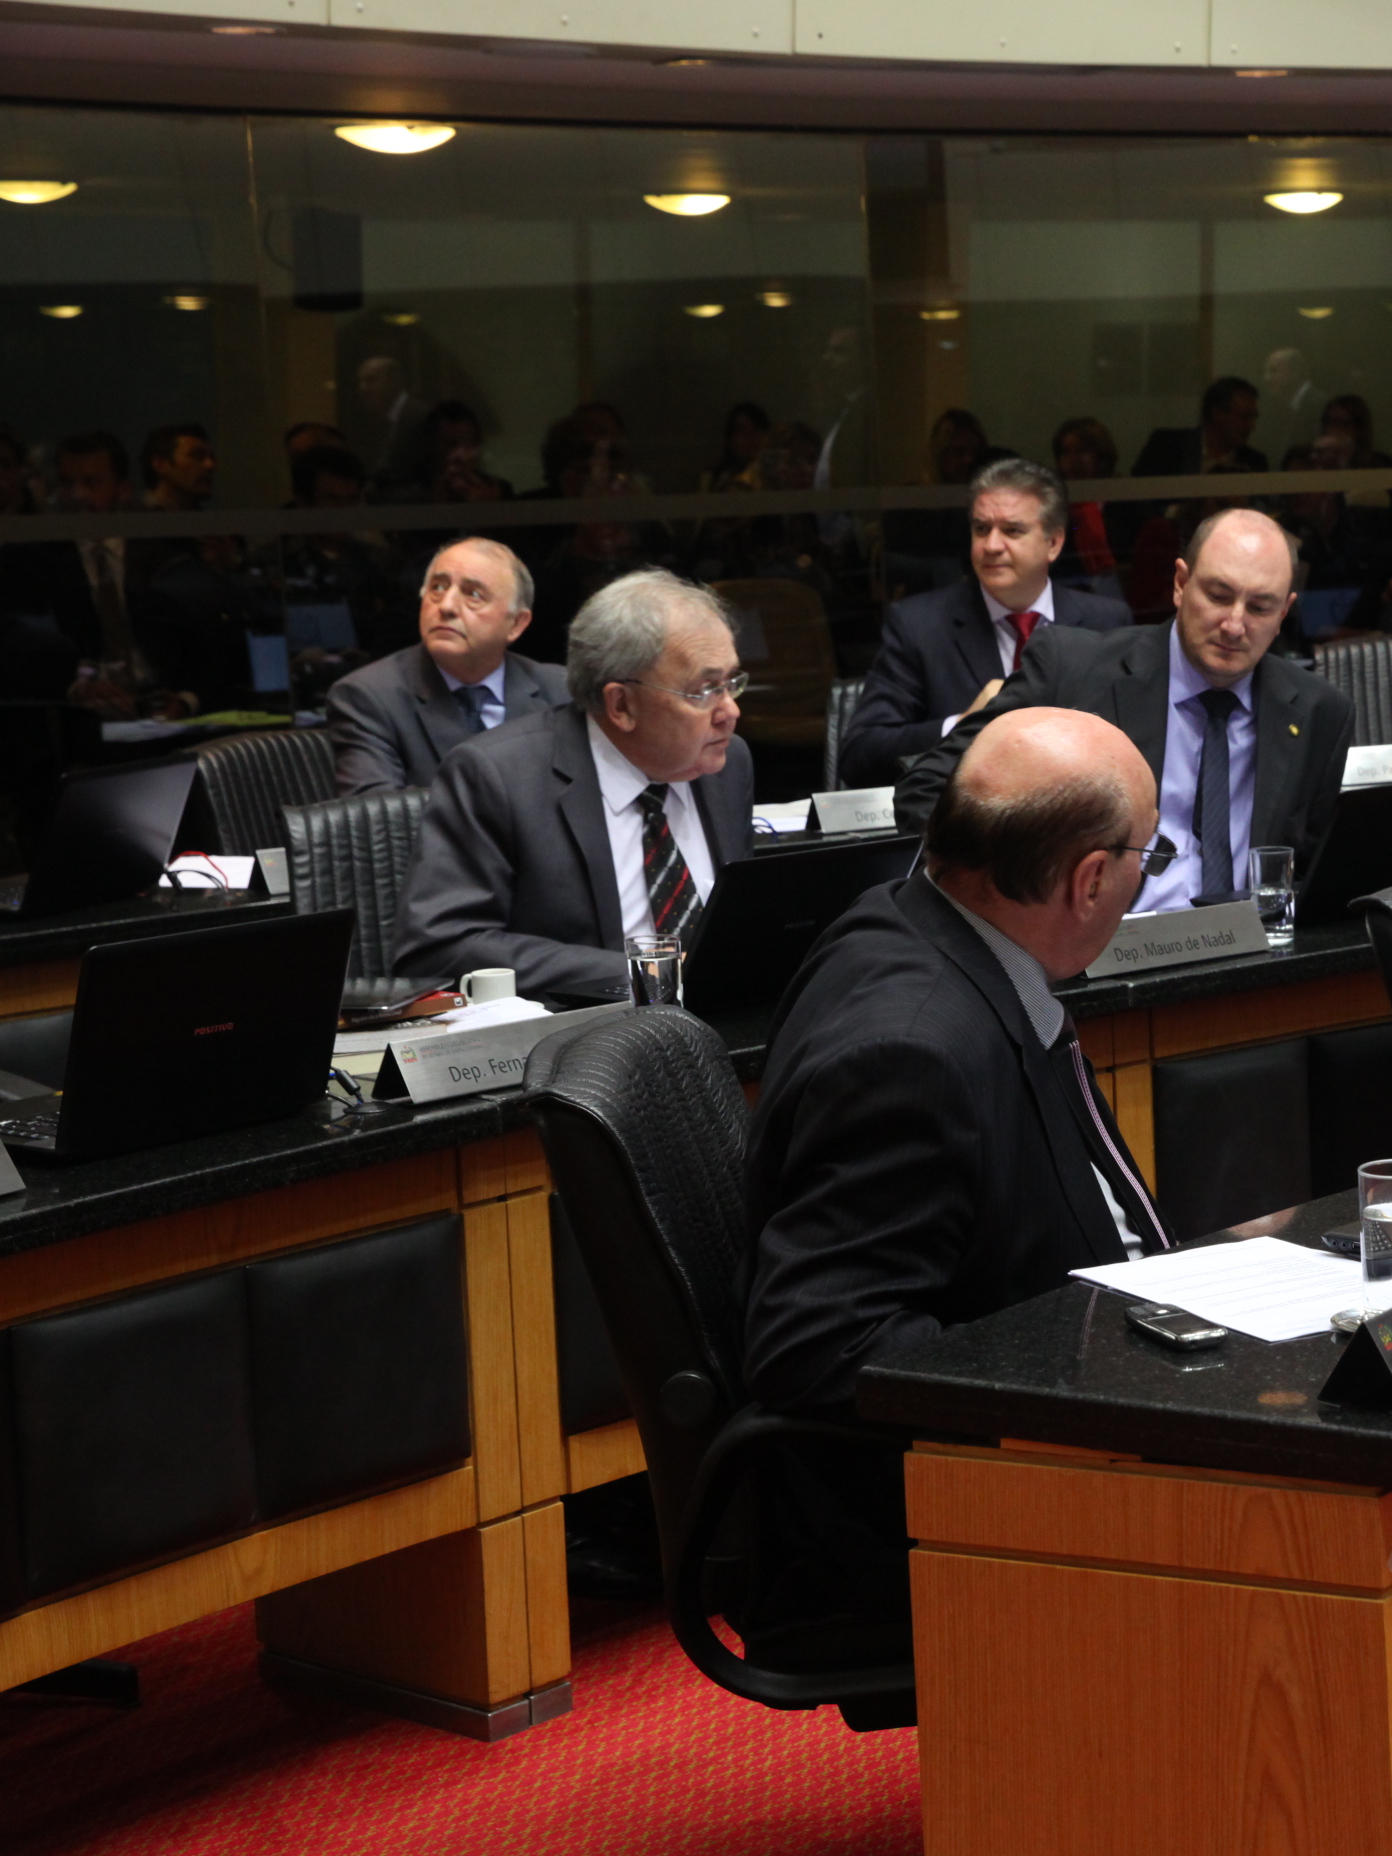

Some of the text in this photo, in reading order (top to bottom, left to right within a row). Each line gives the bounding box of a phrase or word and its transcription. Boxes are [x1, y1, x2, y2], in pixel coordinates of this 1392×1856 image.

[855, 810, 880, 823] Dep.
[1113, 929, 1236, 963] Dep. Mauro de Nadal
[193, 1022, 234, 1036] POSITIVO
[448, 1065, 487, 1083] Dep.
